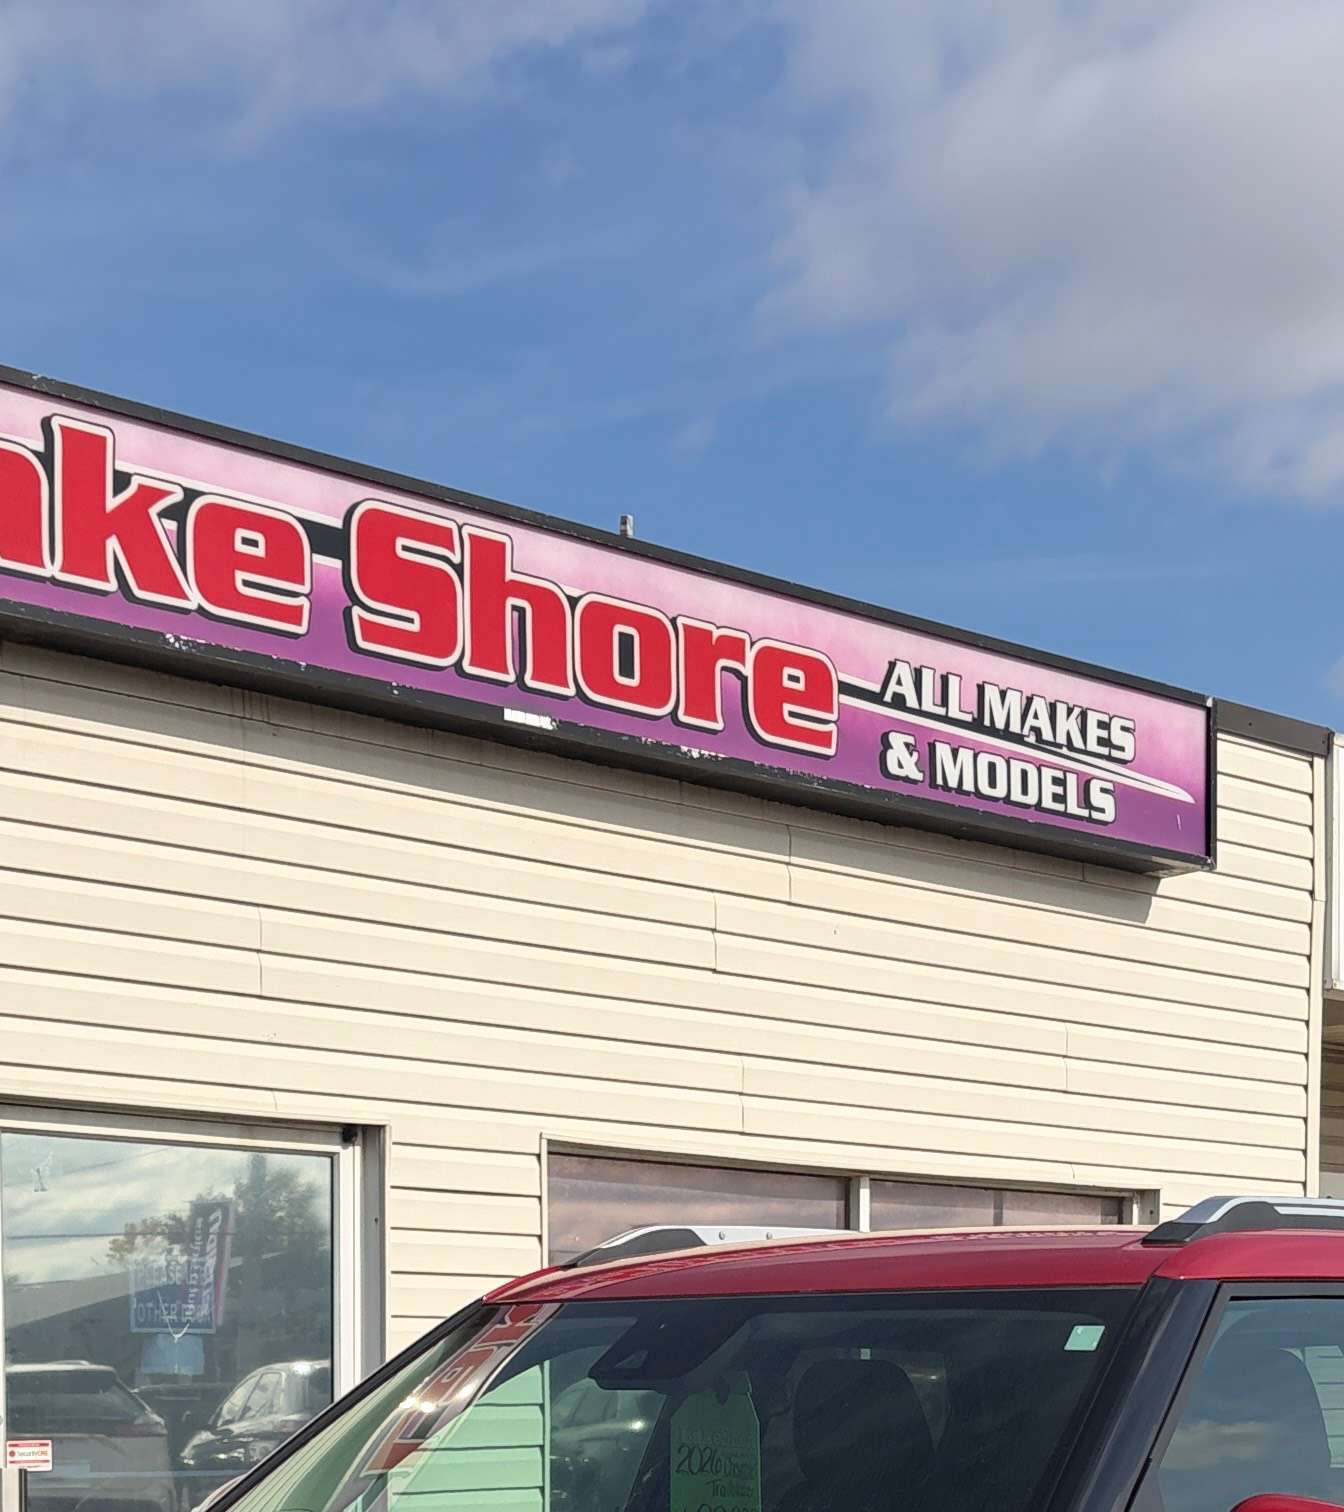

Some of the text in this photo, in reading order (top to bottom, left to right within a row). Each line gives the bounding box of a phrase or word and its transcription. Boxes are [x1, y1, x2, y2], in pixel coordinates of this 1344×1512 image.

[345, 498, 838, 758] Shore
[883, 659, 1135, 763] ALL MAKES
[881, 730, 1116, 824] & MODELS
[676, 1443, 723, 1475] 2026
